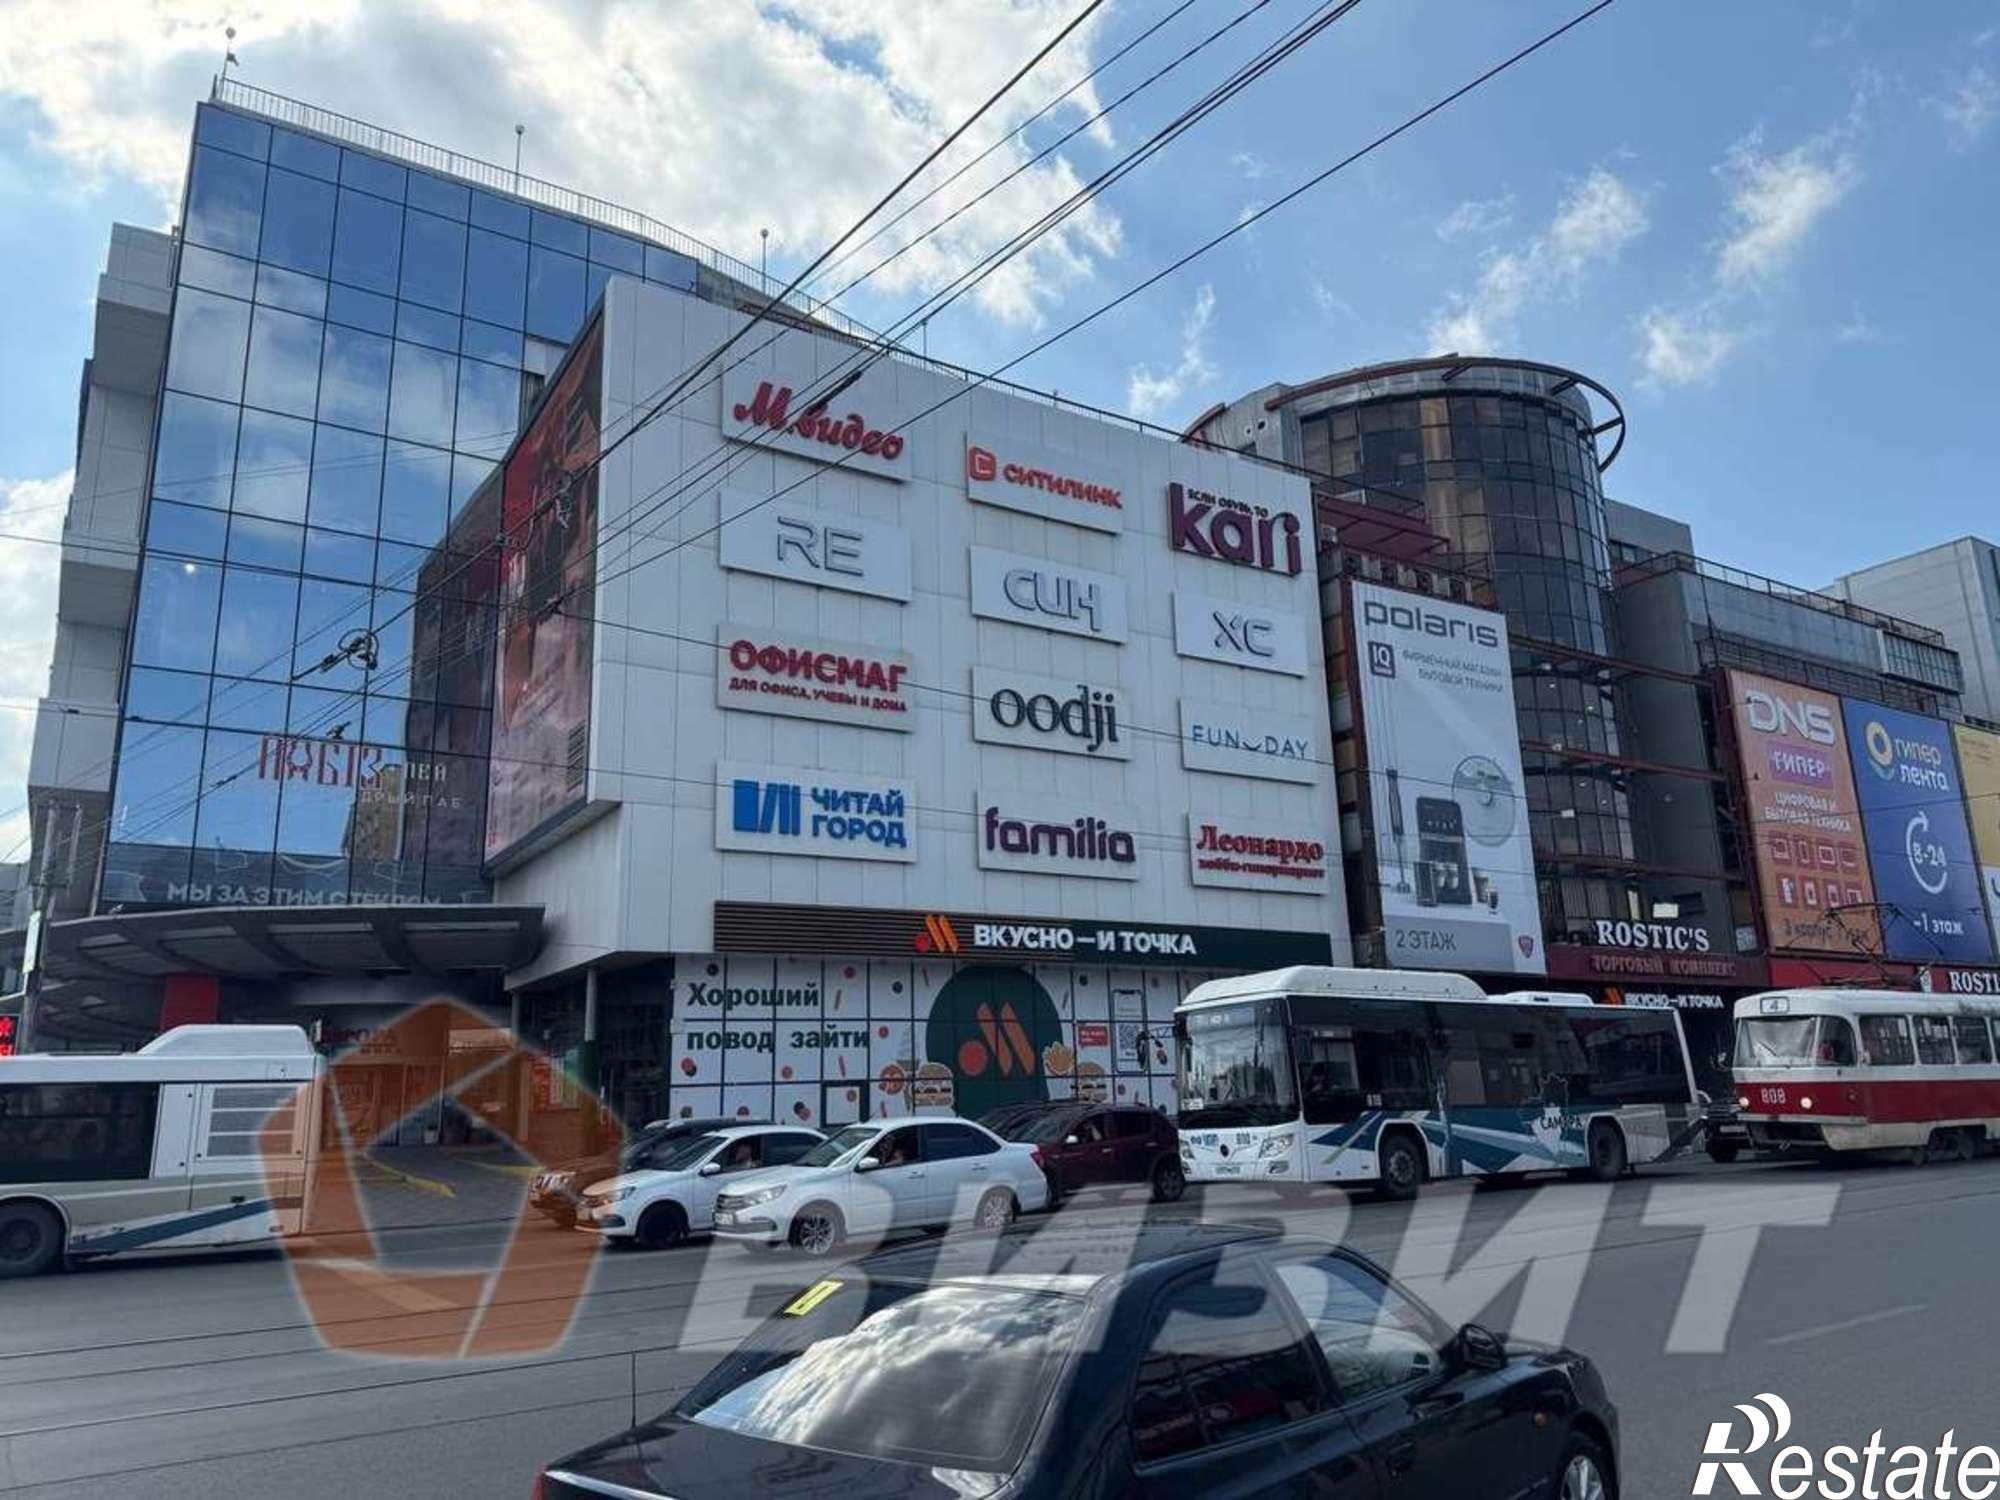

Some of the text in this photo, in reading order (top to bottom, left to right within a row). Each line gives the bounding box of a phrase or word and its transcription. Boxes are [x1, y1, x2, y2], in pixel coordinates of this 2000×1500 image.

[1003, 463, 1122, 510] СИТИЛИНК
[776, 515, 865, 577] RE
[1168, 482, 1303, 578] kari
[1363, 601, 1499, 648] polaris
[729, 639, 908, 693] ОФИСМАГ
[728, 676, 758, 694] ДЛЯ
[760, 681, 812, 701] ОФИСА,
[859, 695, 870, 708] И
[871, 697, 908, 713] ДОМА
[990, 684, 1120, 752] oodji
[1748, 688, 1835, 746] DNS
[1191, 724, 1309, 759] FUN DAY
[1899, 763, 1949, 792] лента
[811, 786, 905, 818] ЧИТАЙ
[811, 814, 908, 849] ГОРОД
[985, 806, 1136, 863] familia
[1196, 825, 1325, 864] Леонардо
[168, 882, 211, 901] МЫ
[216, 884, 249, 902] ЗА
[972, 923, 1074, 950] ВКУСНО
[1119, 930, 1198, 955] ТОЧКА
[1395, 929, 1457, 951] 2 ЭТАЖ
[1595, 920, 1710, 952] ROSTIC'S
[687, 981, 819, 1011] Хороший
[687, 1023, 871, 1054] повод зайти
